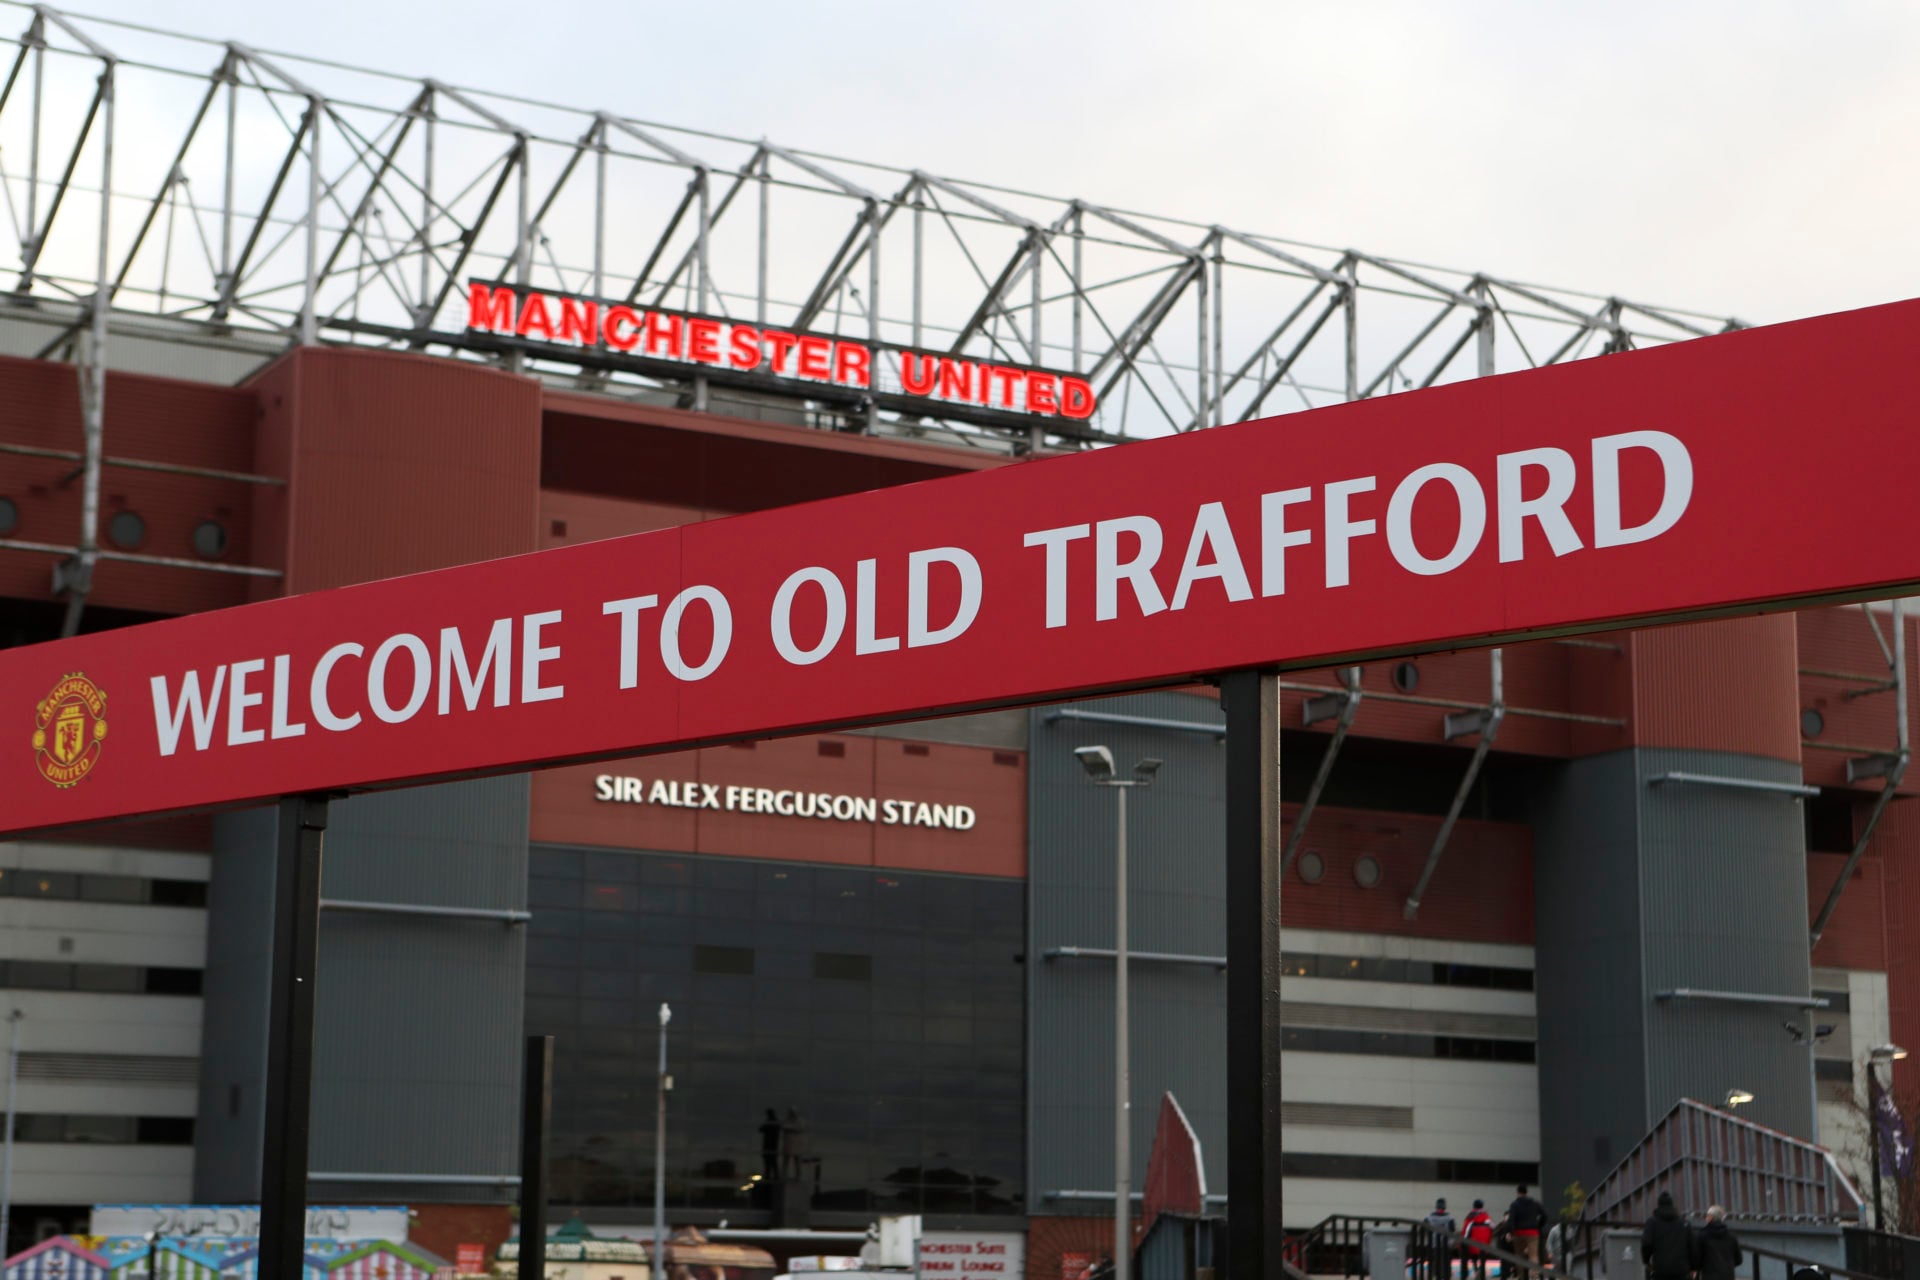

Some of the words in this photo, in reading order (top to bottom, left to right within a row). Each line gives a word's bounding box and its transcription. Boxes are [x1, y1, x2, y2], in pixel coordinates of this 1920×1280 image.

[466, 282, 871, 387] MANCHESTER
[899, 350, 1097, 420] UNITED
[150, 609, 565, 757] WELCOME
[602, 584, 733, 690] TO
[770, 546, 983, 666] OLD
[1023, 430, 1694, 629] TRAFFORD
[41, 680, 102, 721] MANCHESTER
[46, 758, 90, 781] UNITED
[595, 774, 643, 804] SIR
[648, 779, 720, 810] ALEX
[725, 785, 877, 823] FERGUSON
[882, 798, 977, 831] STAND
